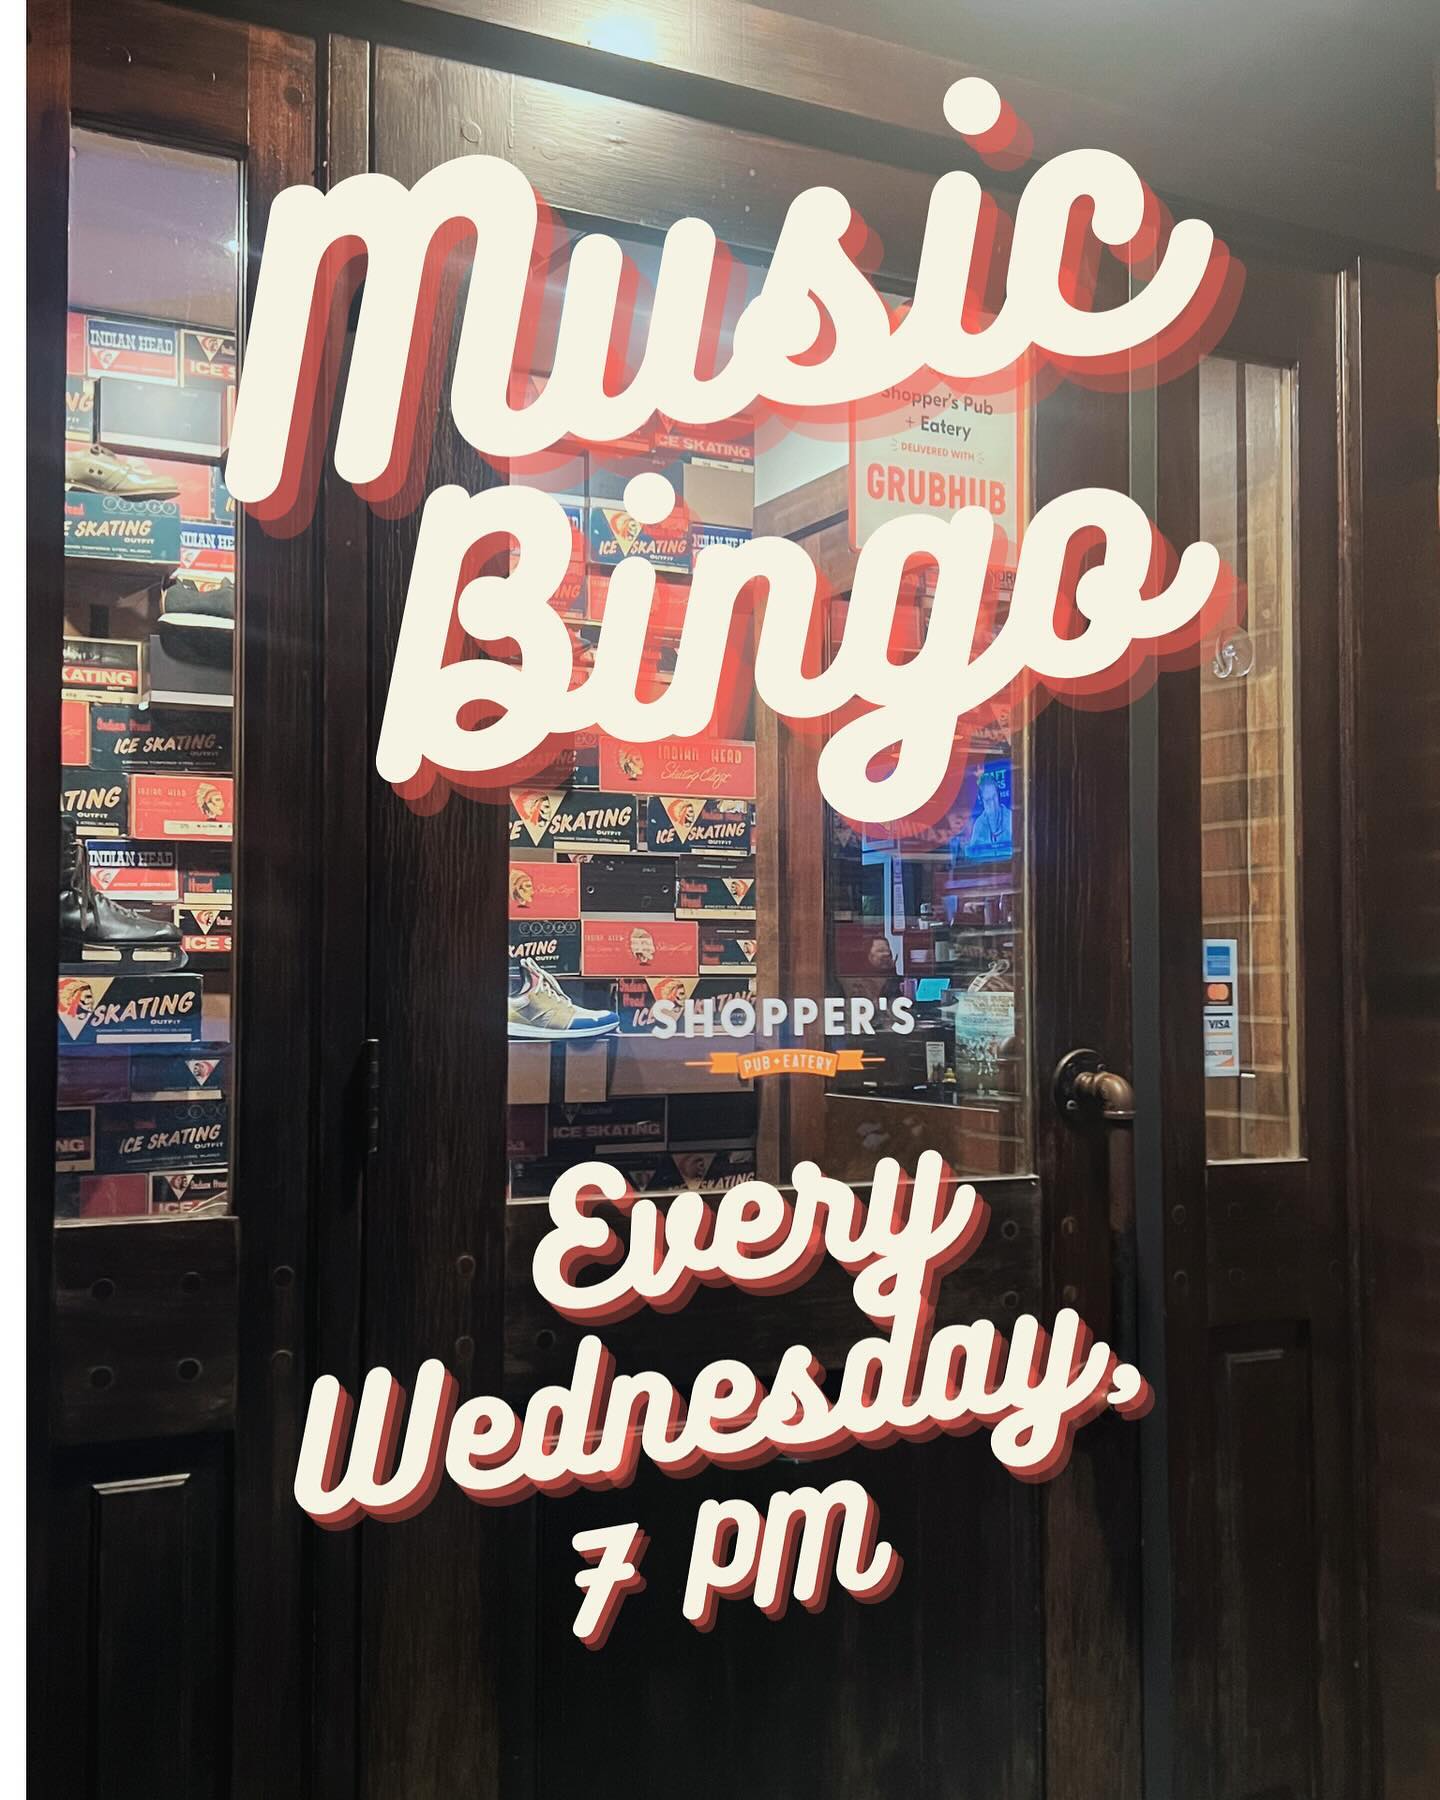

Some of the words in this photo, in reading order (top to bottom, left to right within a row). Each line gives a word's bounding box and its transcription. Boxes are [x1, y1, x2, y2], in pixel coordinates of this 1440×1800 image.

[90, 330, 136, 350] INDIAN
[138, 335, 173, 355] HEAD
[191, 361, 223, 376] ICE
[881, 386, 960, 410] Shopper's
[964, 396, 993, 416] Pub
[920, 416, 972, 442] Eatery
[683, 438, 750, 458] SKATING
[901, 442, 949, 457] DELIVERED
[951, 450, 975, 462] WITH
[867, 463, 1006, 516] GRUBHUB
[74, 520, 153, 538] SKATING
[124, 537, 155, 545] OUTFIT
[599, 540, 617, 555] ICE
[630, 540, 688, 555] SKATING
[113, 738, 140, 754] ICE
[143, 734, 216, 752] SKATING
[711, 749, 742, 764] HEAD
[61, 786, 121, 811] TING
[549, 806, 632, 834] SKATING
[656, 828, 675, 844] ICE
[688, 822, 746, 840] SKATING
[89, 850, 136, 867] INDIAN
[138, 851, 173, 867] HEAD
[185, 937, 219, 950] ICE
[91, 991, 196, 1027] SKATING
[651, 997, 915, 1039] SHOPPER'S
[1208, 1020, 1230, 1029] VISA
[743, 1057, 770, 1073] PUB
[783, 1054, 833, 1072] EATERY
[118, 1136, 144, 1154] ICE
[147, 1124, 221, 1150] SKATING
[553, 1127, 583, 1138] ICE
[586, 1123, 660, 1137] SKATING
[194, 1141, 224, 1149] OUTFIT
